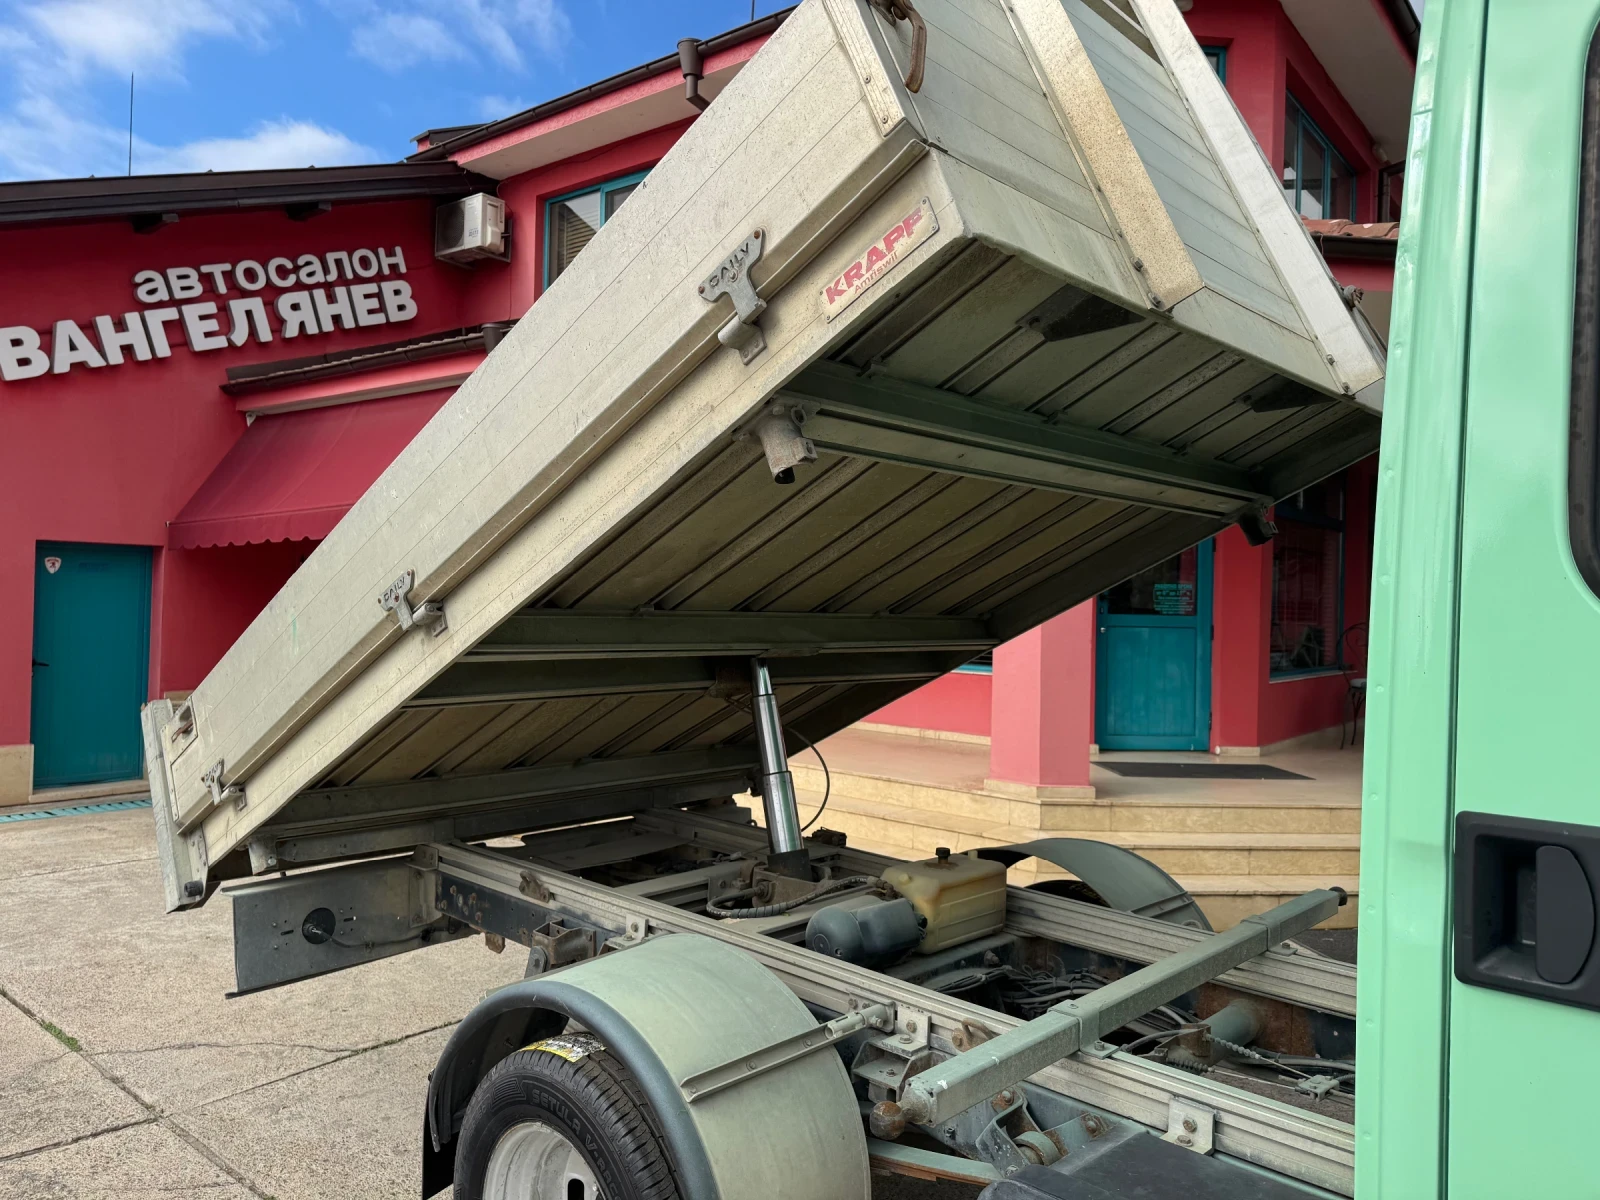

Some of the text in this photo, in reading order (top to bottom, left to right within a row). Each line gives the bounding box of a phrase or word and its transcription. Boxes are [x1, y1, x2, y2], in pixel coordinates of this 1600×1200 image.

[134, 246, 408, 303] автосалон
[854, 252, 898, 294] Amriswil
[0, 280, 418, 381] ВАНГЕЛ ЯНЕВ
[530, 1088, 621, 1200] SETULA V-RAC
